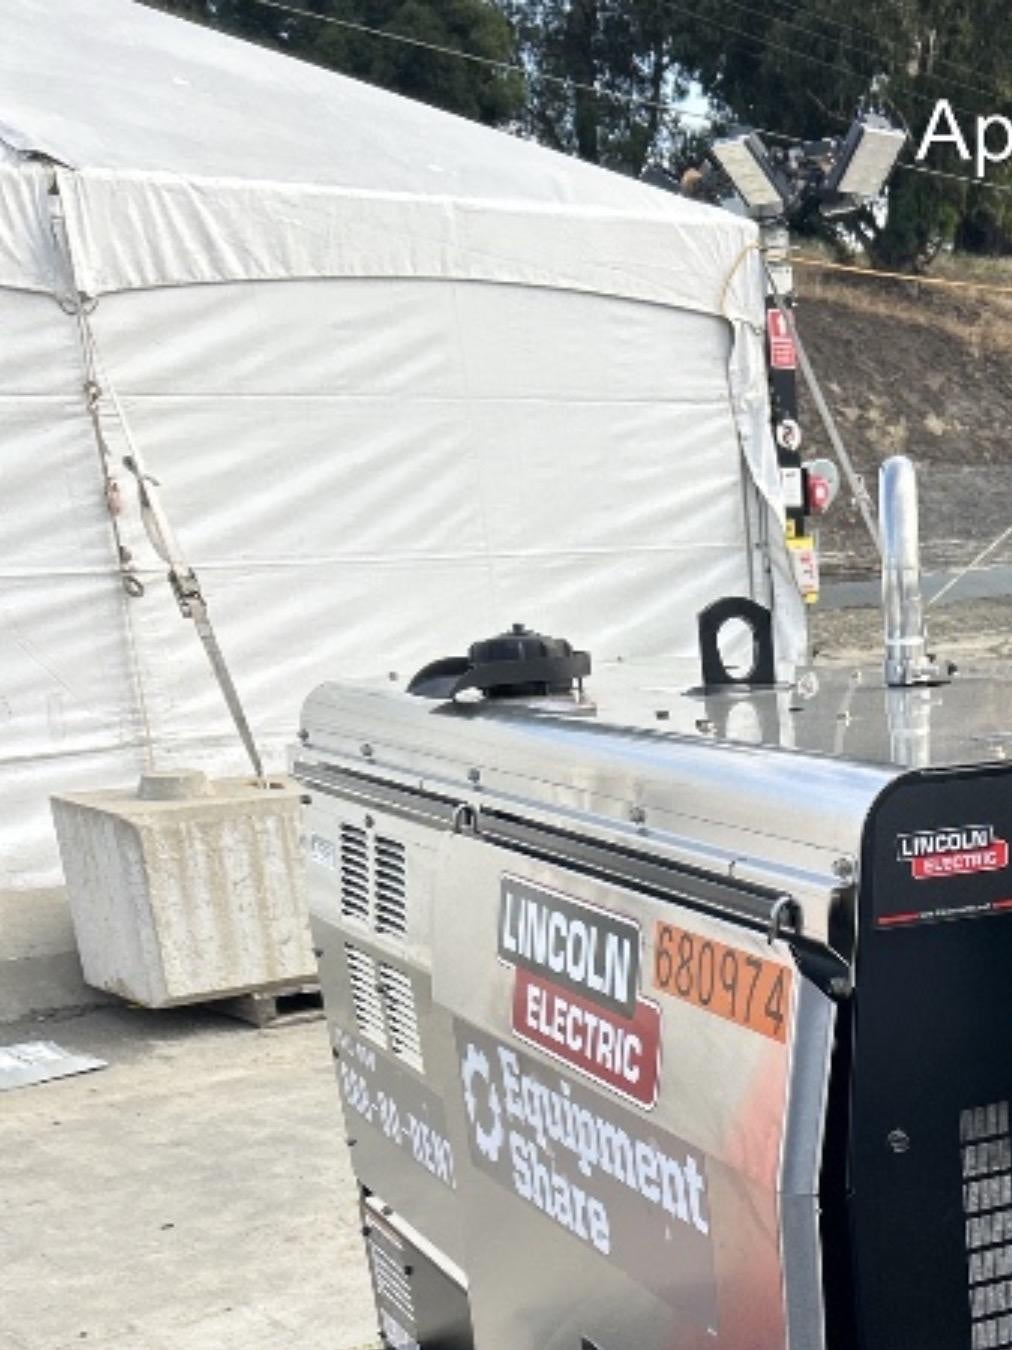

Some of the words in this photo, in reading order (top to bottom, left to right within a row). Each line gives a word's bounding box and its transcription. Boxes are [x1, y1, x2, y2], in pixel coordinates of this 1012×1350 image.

[901, 829, 988, 857] LINCOLN
[922, 850, 998, 872] ELECTRIC
[501, 891, 632, 1003] LINCOLN
[656, 924, 786, 1036] 680974
[525, 982, 643, 1084] ELECTRIC
[497, 1045, 710, 1235] Equipment
[508, 1129, 611, 1255] Share
